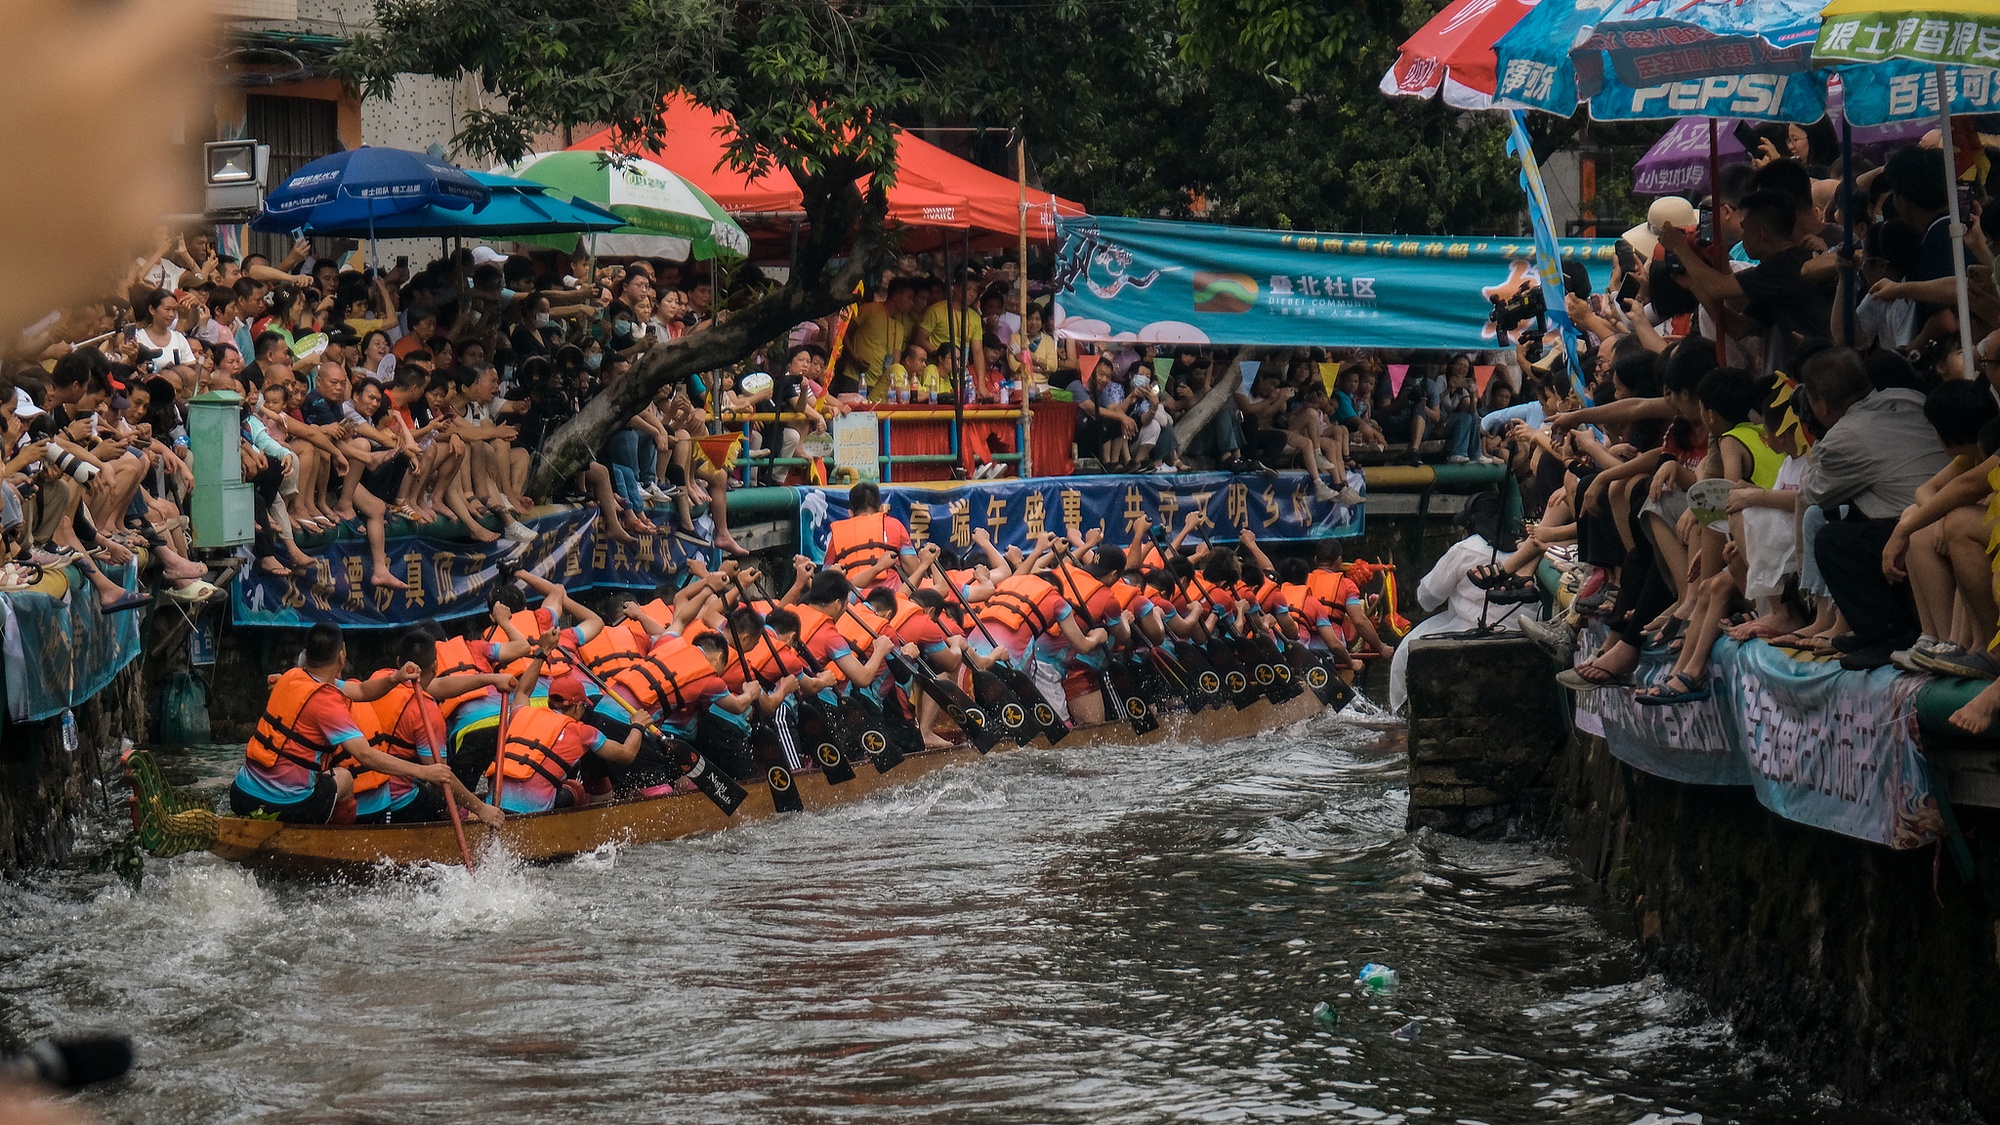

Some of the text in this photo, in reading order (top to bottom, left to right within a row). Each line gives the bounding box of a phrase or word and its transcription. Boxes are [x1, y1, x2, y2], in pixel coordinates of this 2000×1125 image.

[1631, 74, 1788, 116] PEPSI
[923, 207, 955, 220] HUAWEI
[706, 772, 732, 805] Night Kids
